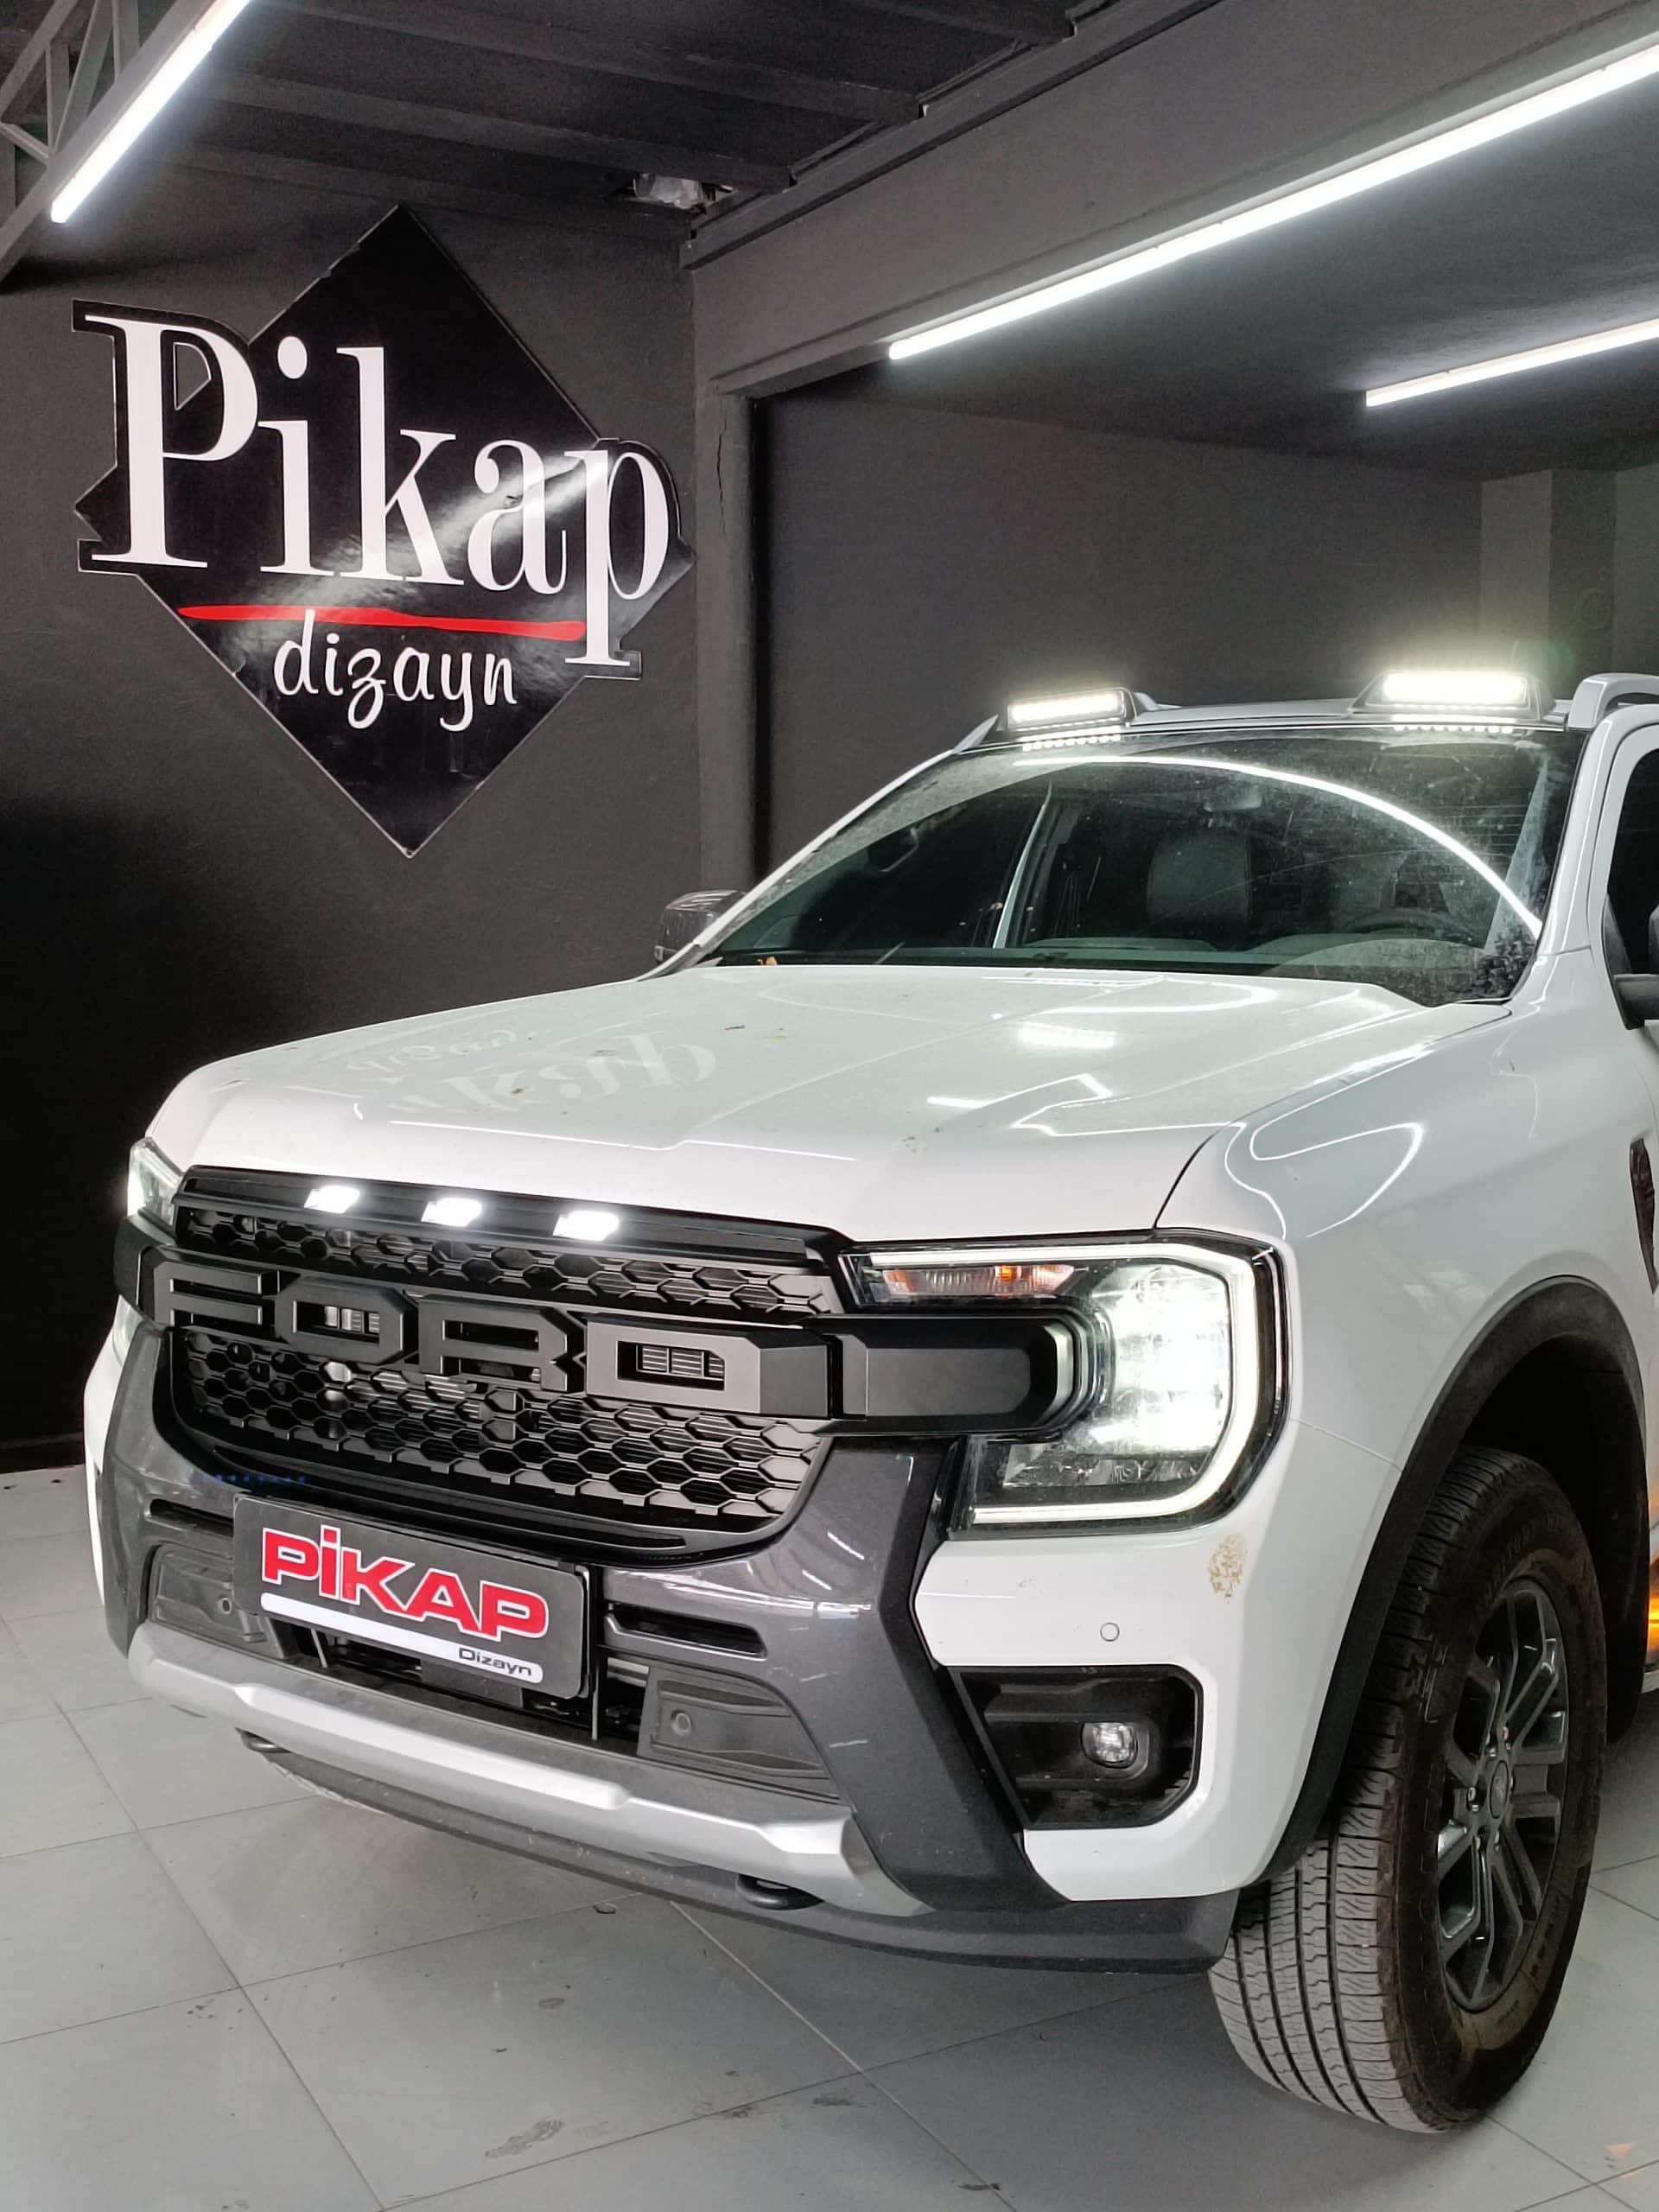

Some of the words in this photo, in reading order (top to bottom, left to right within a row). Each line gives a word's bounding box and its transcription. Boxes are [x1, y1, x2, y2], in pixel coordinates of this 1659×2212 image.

[85, 315, 670, 666] Pikap
[273, 608, 518, 731] dizayn
[153, 1258, 762, 1414] FORD
[458, 1646, 532, 1677] Dizayn
